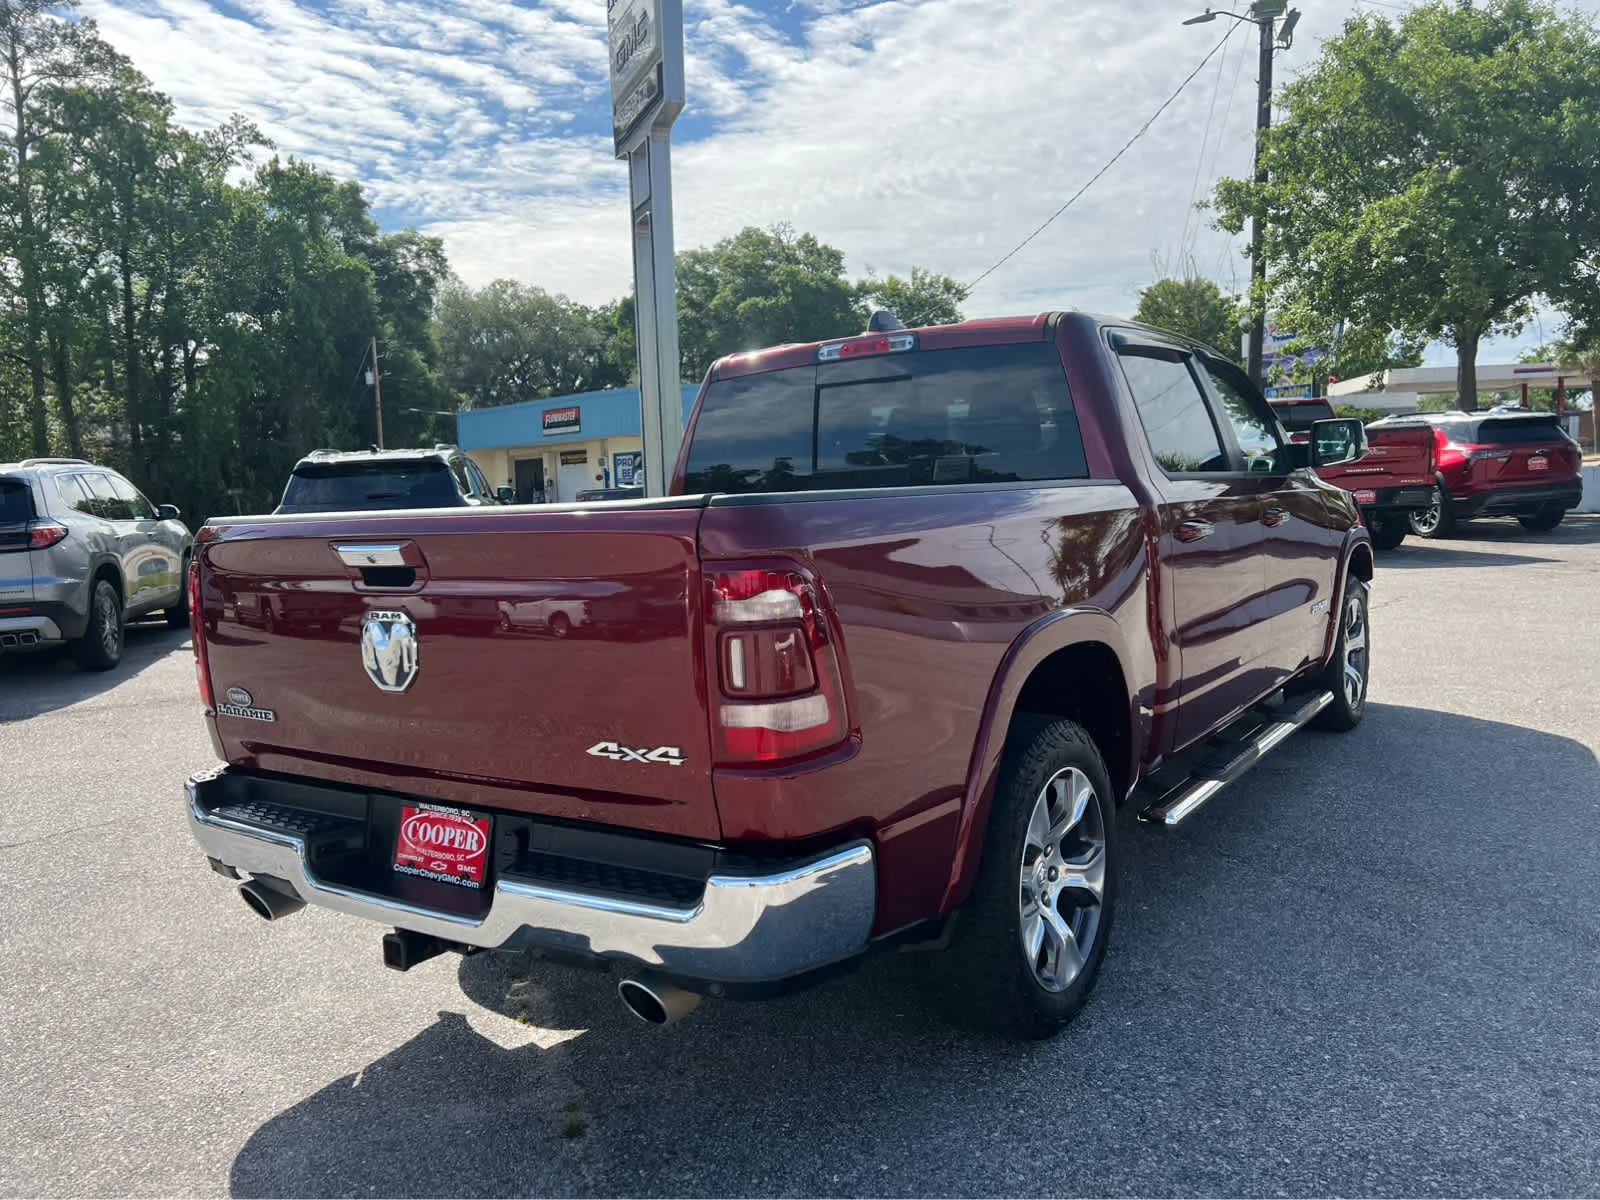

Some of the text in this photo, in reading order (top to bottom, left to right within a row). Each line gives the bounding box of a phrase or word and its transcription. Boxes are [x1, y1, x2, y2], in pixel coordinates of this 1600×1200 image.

[616, 8, 648, 73] GMC
[370, 612, 402, 620] RAM
[217, 703, 273, 721] LARAMIE
[407, 820, 479, 852] COOPER
[393, 863, 479, 889] CooperChevyGMC.com
[457, 864, 477, 874] GMC
